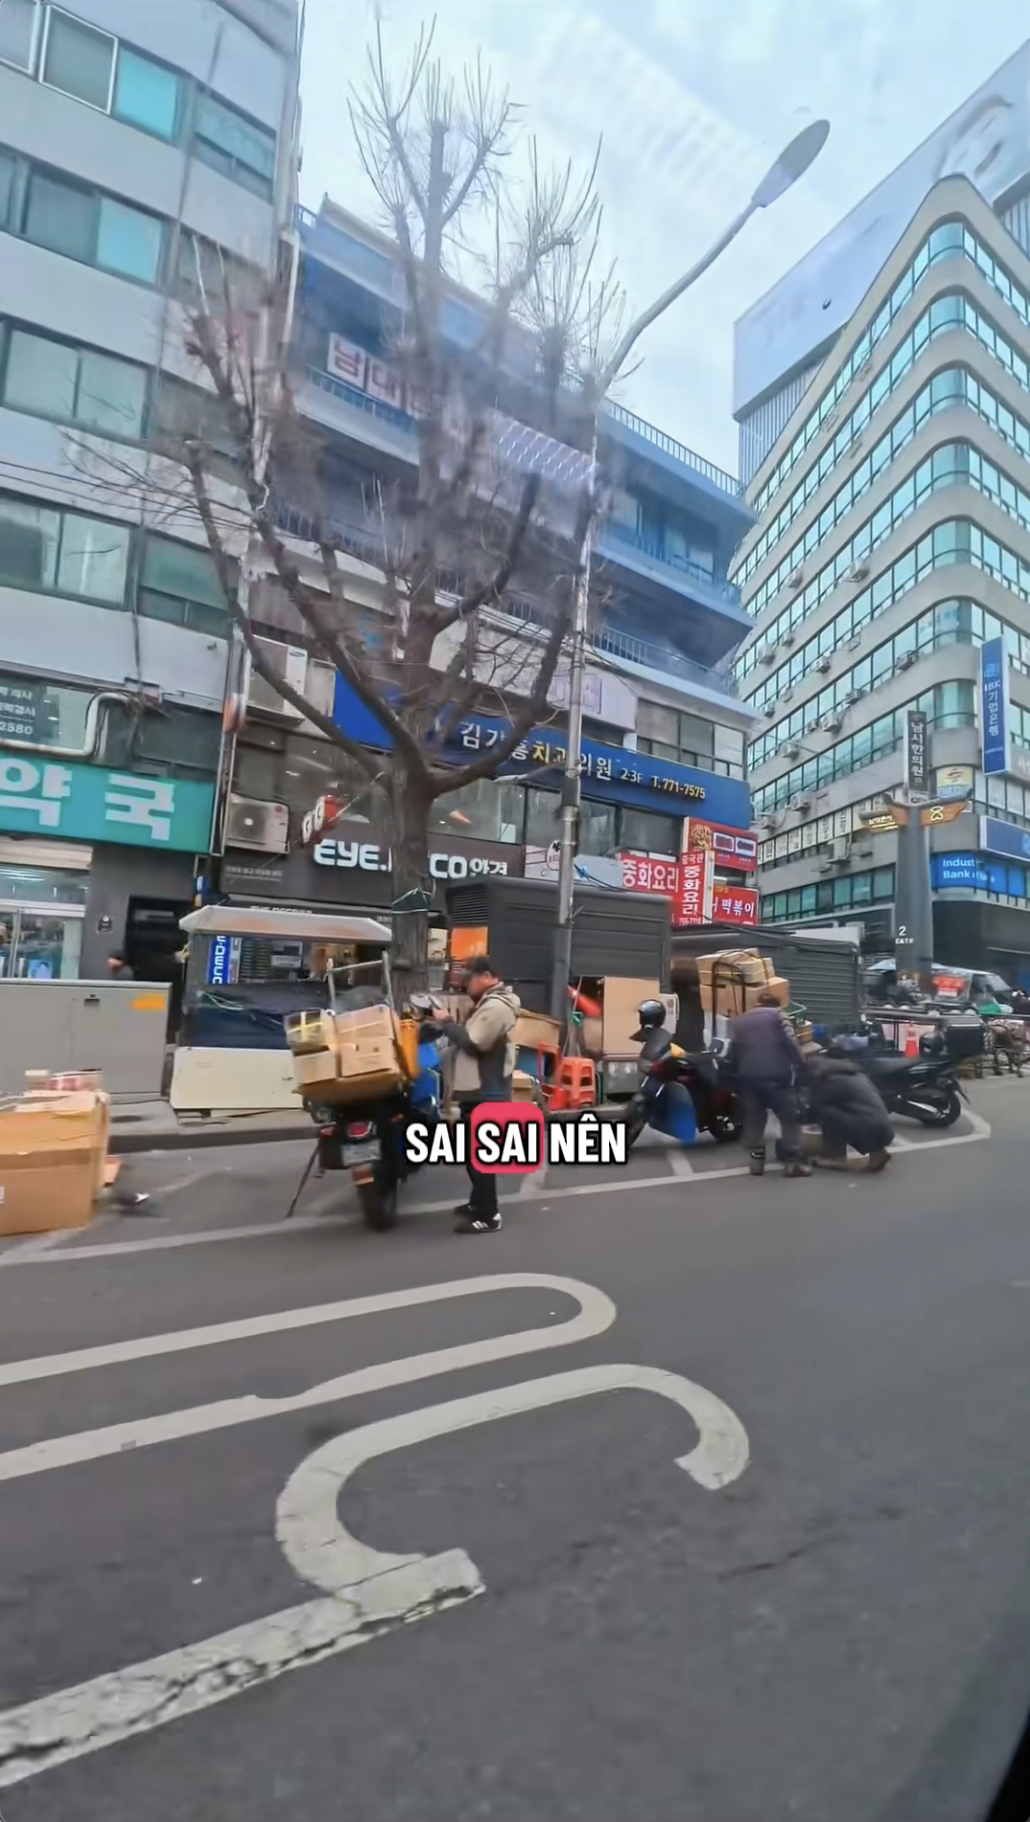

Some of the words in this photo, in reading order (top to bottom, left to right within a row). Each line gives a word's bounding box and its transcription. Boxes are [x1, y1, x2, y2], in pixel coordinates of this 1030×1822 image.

[988, 691, 999, 736] 기업은행
[622, 858, 679, 893] 중화요리
[682, 865, 701, 915] 중화요리
[943, 869, 970, 879] Bank
[899, 926, 906, 936] 2
